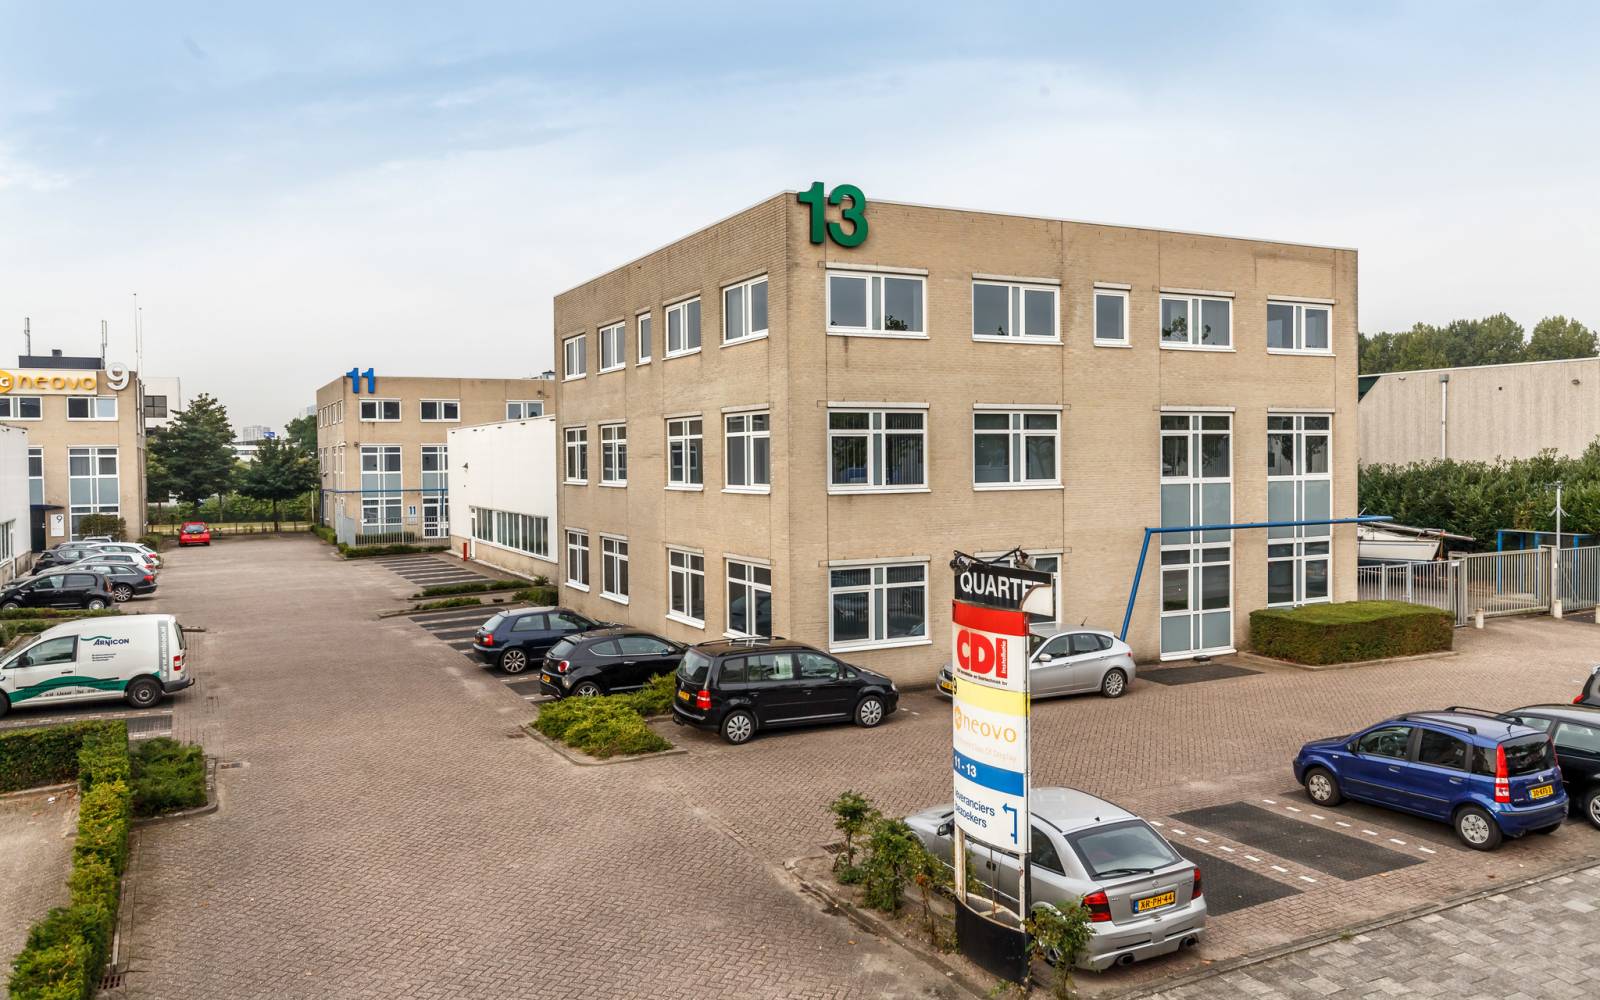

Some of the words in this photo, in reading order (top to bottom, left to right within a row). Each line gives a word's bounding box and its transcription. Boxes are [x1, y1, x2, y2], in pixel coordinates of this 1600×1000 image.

[796, 181, 869, 249] 13
[18, 374, 97, 391] neovo
[106, 363, 130, 391] 9
[346, 367, 375, 393] 11
[56, 515, 63, 524] 9
[409, 505, 416, 515] 11
[960, 571, 1047, 601] QUARTE
[93, 638, 130, 647] ARNICON
[957, 629, 1008, 679] CDI
[963, 714, 1017, 744] neovo
[966, 763, 977, 778] 13
[1141, 894, 1172, 908] XR-PH-44
